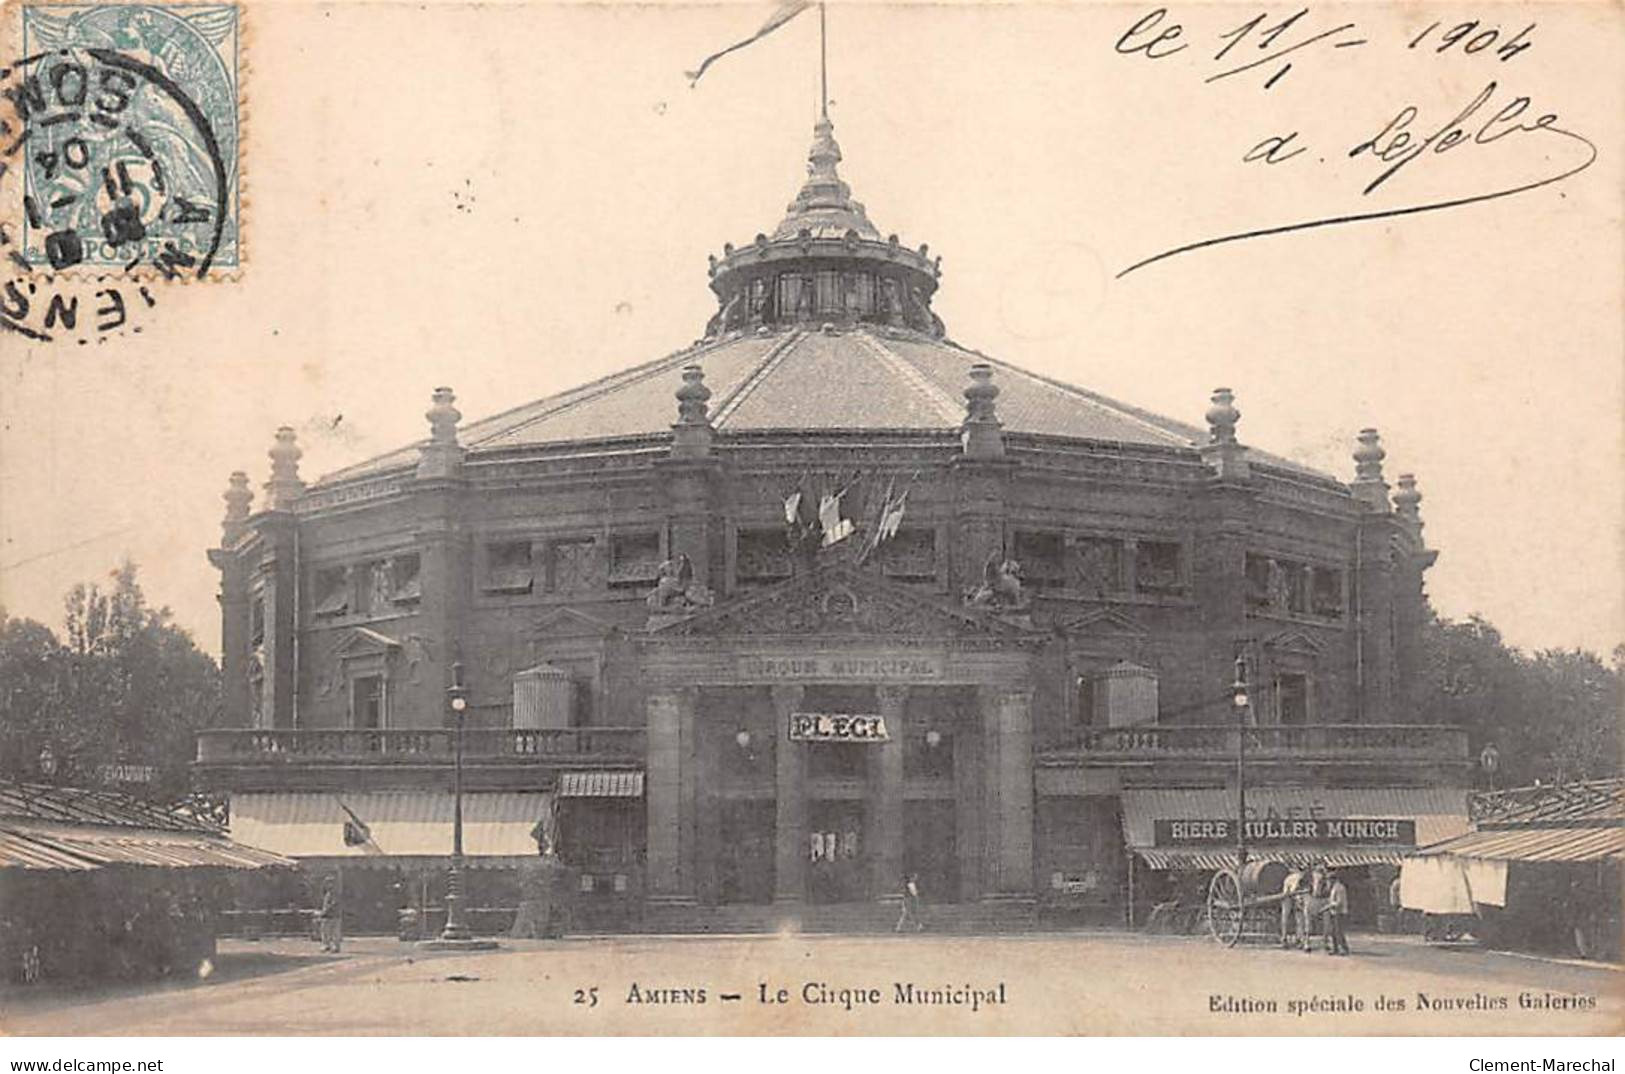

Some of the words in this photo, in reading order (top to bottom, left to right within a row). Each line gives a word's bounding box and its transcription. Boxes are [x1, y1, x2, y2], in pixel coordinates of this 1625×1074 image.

[1408, 20, 1533, 62] 1904
[1171, 822, 1228, 839] BIERE
[1327, 821, 1400, 838] MUNICH
